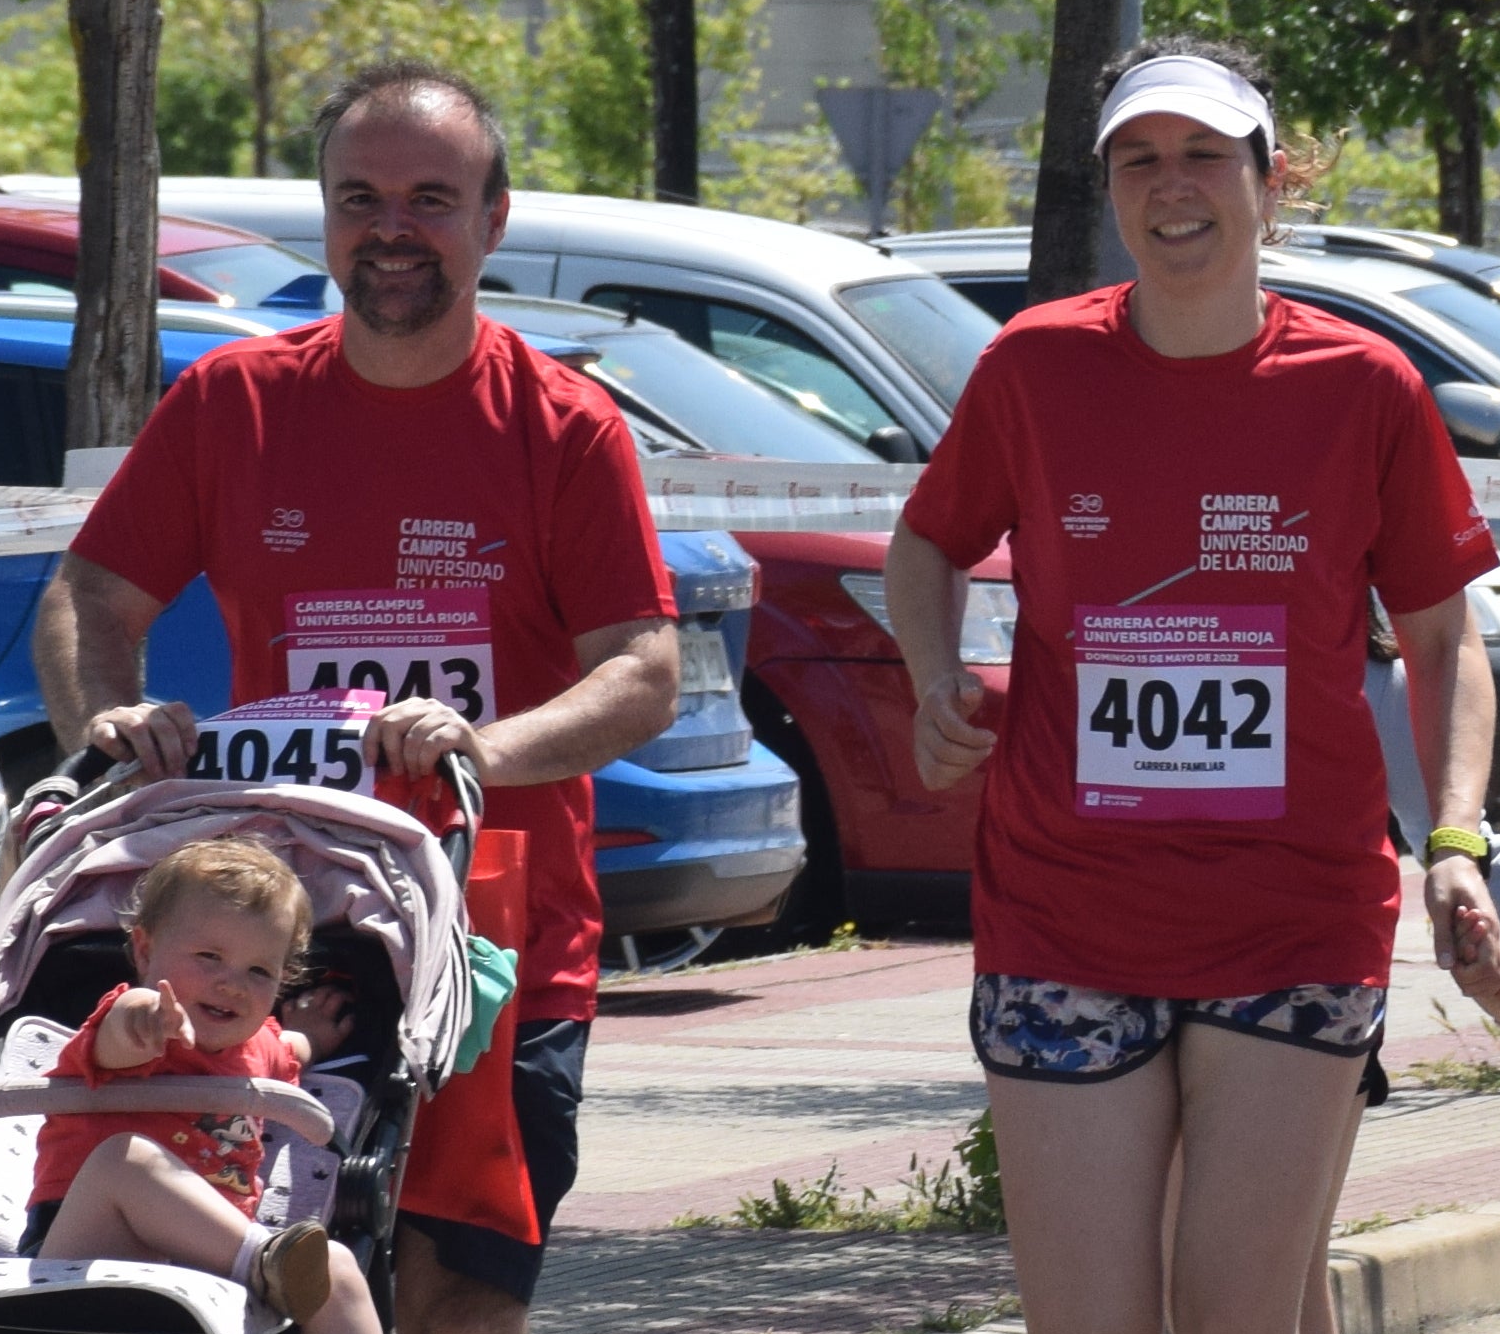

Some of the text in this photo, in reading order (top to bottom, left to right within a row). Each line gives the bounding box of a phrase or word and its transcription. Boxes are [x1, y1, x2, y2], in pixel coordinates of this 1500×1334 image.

[1200, 494, 1280, 512] CARRERA
[400, 518, 476, 539] CARRERA
[1200, 514, 1272, 532] CAMPUS
[399, 538, 467, 558] CAMPUS
[1200, 534, 1309, 552] UNIVERSIDAD
[397, 559, 505, 580] UNIVERSIDAD
[1199, 553, 1295, 572] DE LA RIOJA
[296, 599, 425, 613] CARRERA CAMPUS
[296, 611, 478, 627] UNIVERSIDAD DE LA RIOJA
[1084, 616, 1219, 629] CARRERA CAMPUS
[297, 635, 350, 646] DOMINGO
[361, 635, 375, 644] DE
[376, 635, 405, 644] MAYO
[406, 635, 419, 644] DE
[420, 634, 446, 644] 2022
[1084, 630, 1275, 645] UNIVERSIDAD DE LA RIOJA
[1085, 652, 1240, 663] DOMINGO 15 DE MAYO DE 2022
[1090, 677, 1272, 751] 4042
[187, 728, 363, 791] 4045
[1133, 761, 1226, 772] CARRERA FAMILIAR
